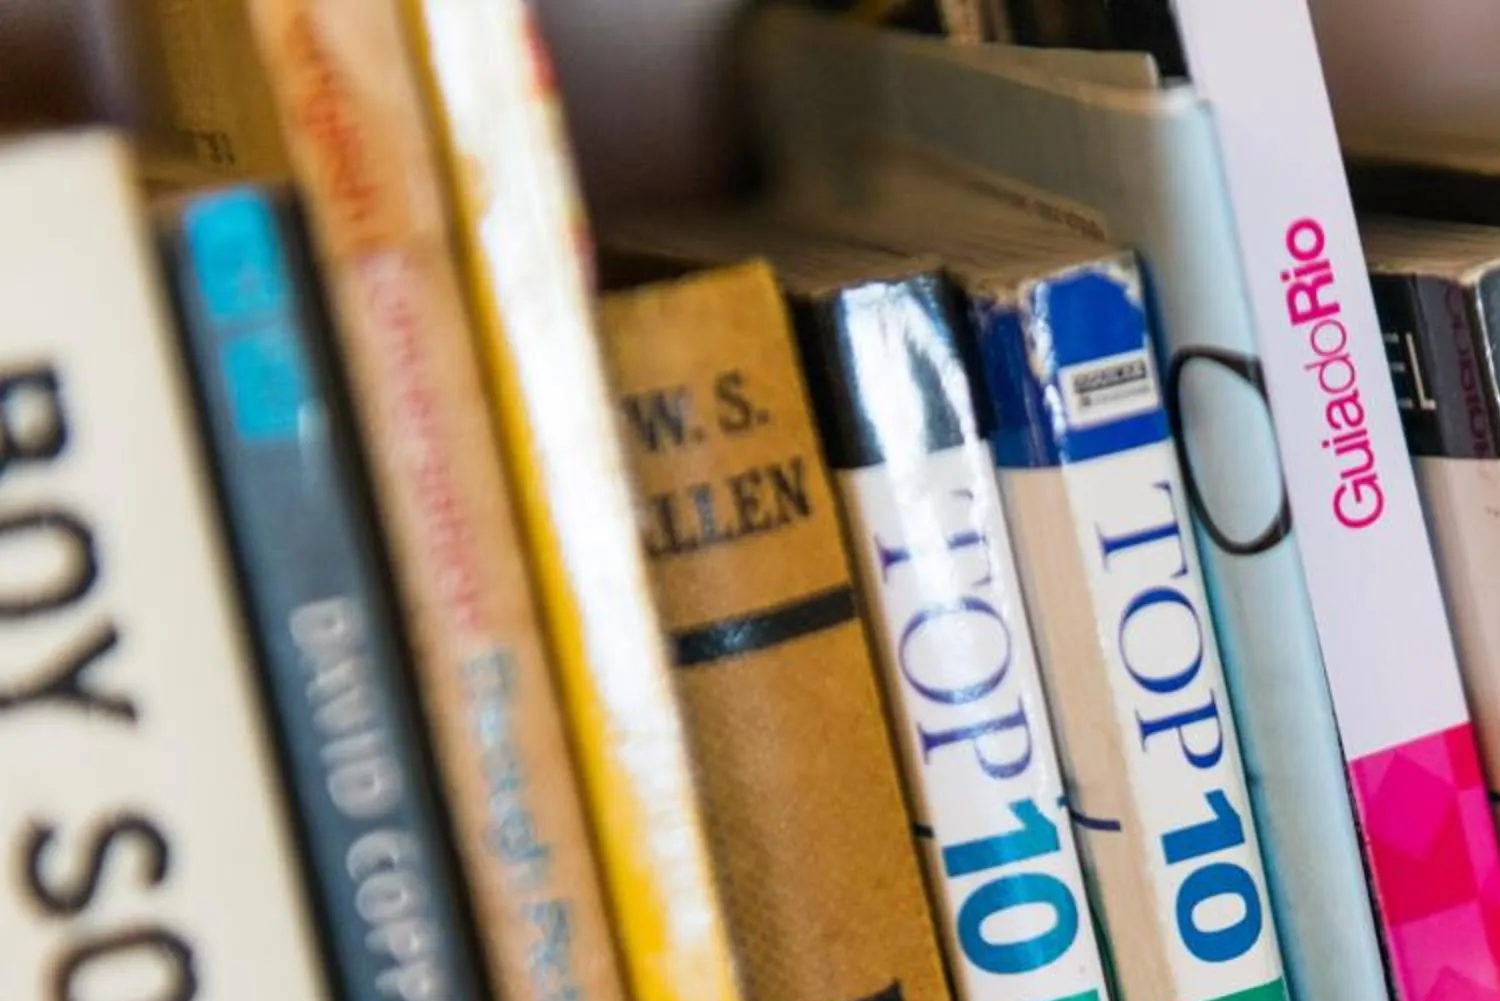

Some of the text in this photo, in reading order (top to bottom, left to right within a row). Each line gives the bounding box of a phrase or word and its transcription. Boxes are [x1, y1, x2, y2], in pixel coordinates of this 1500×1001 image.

[714, 368, 771, 437] S.
[1279, 217, 1386, 530] GuiadoRio
[640, 453, 810, 562] LLEN
[291, 597, 393, 819] DAVID
[875, 485, 1034, 783] TOP
[1100, 481, 1224, 770] TOP
[942, 797, 1079, 975] 10
[1160, 787, 1262, 964] 10
